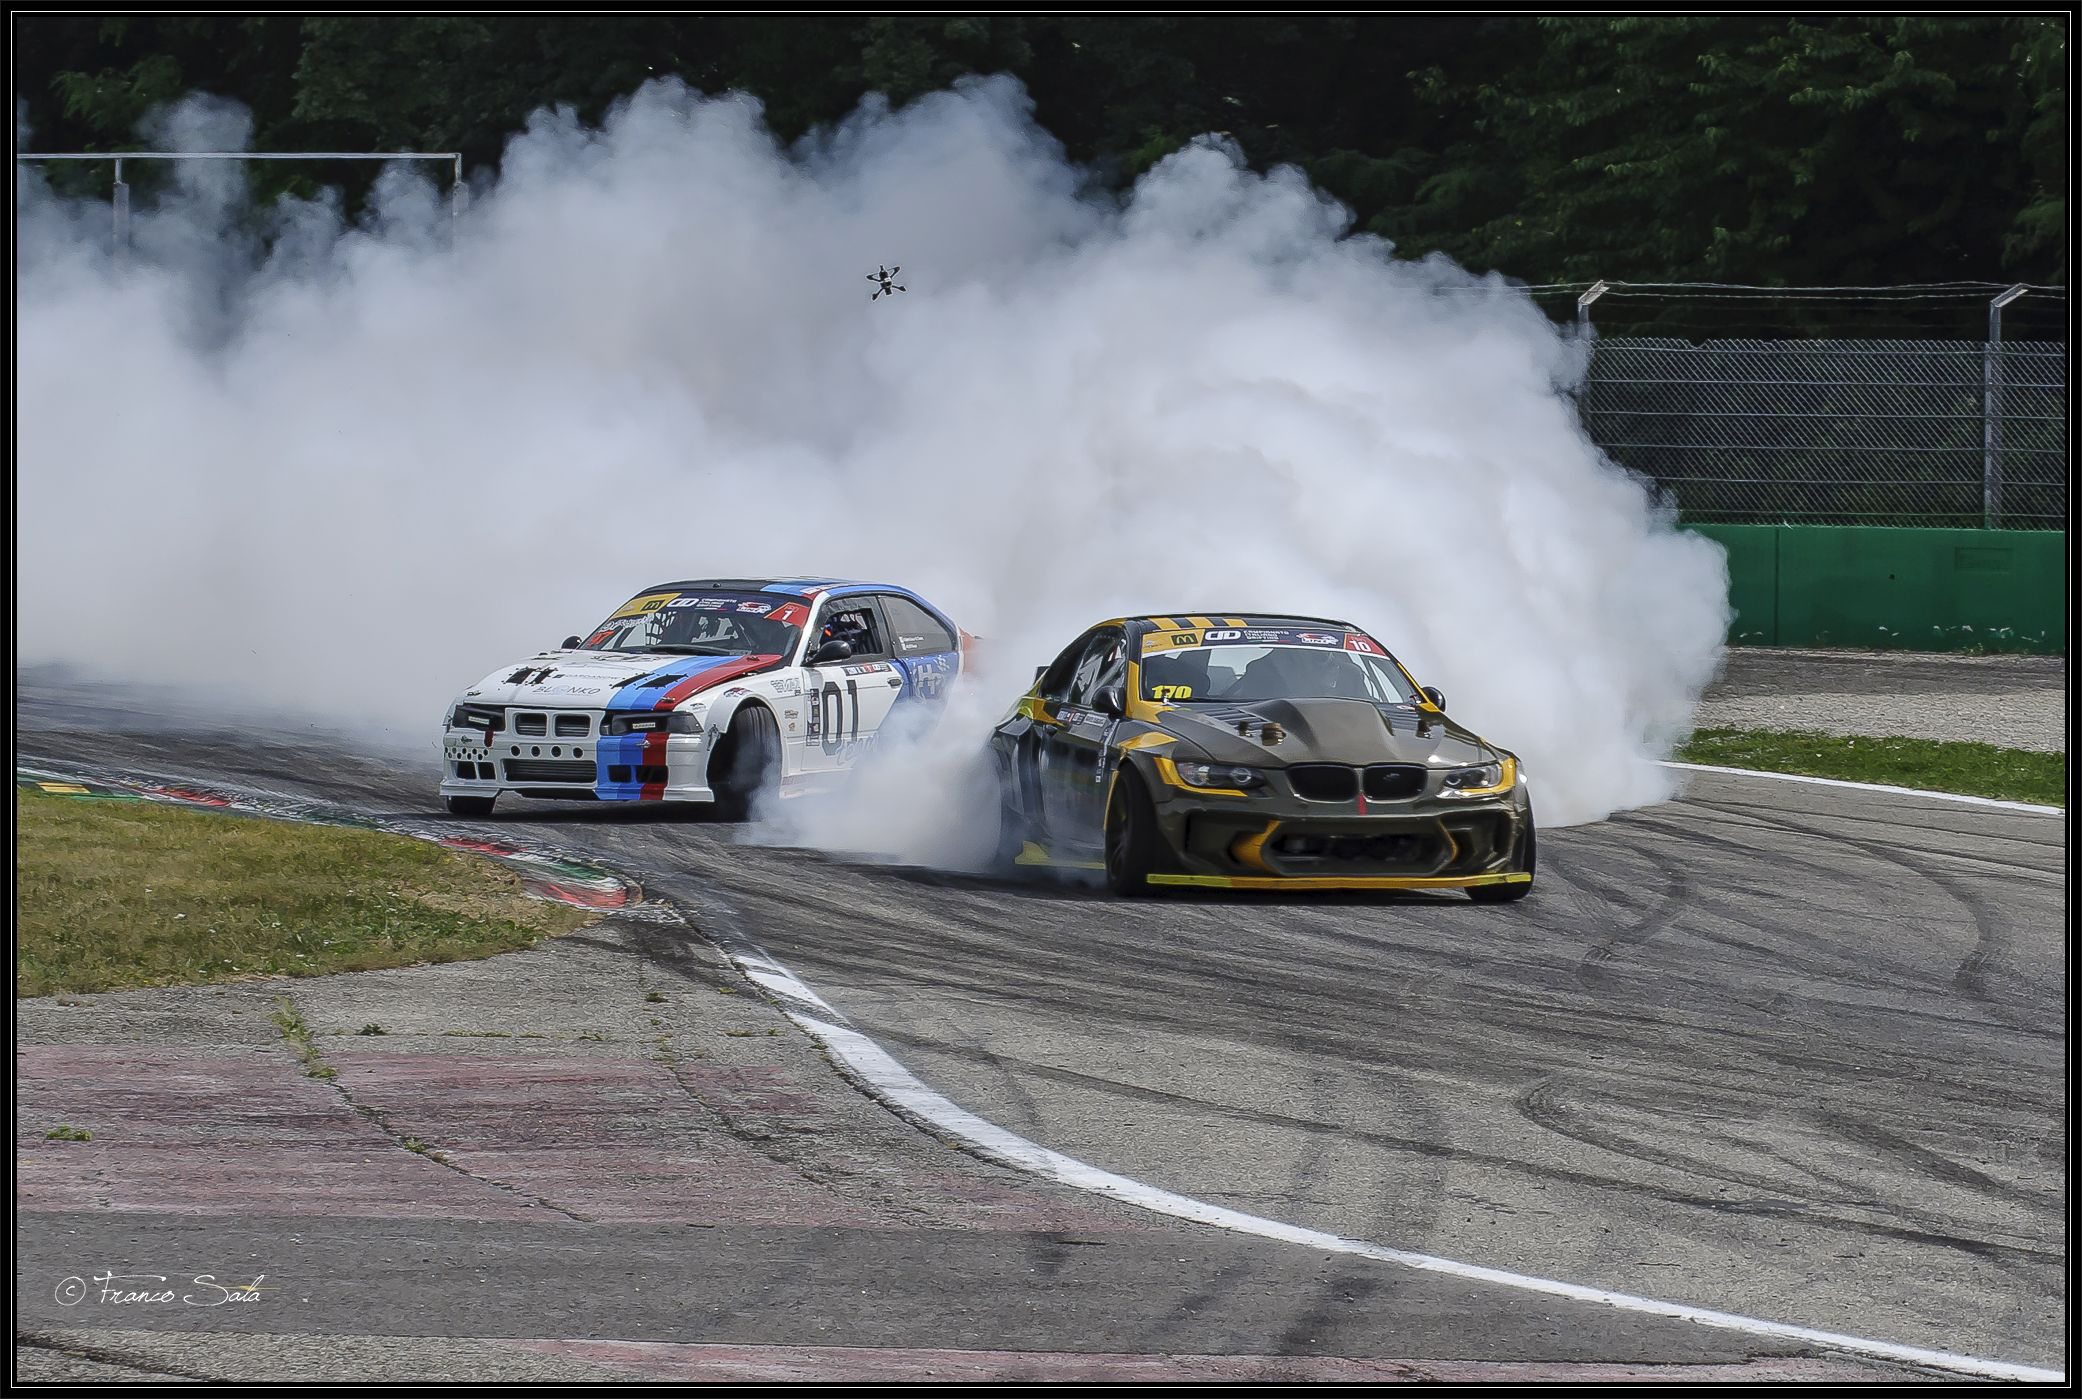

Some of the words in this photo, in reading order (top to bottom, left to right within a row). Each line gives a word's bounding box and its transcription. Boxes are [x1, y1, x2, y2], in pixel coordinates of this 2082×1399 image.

[782, 610, 793, 621] 1
[1348, 639, 1372, 652] 10
[1151, 684, 1192, 699] 170
[821, 679, 859, 757] 01
